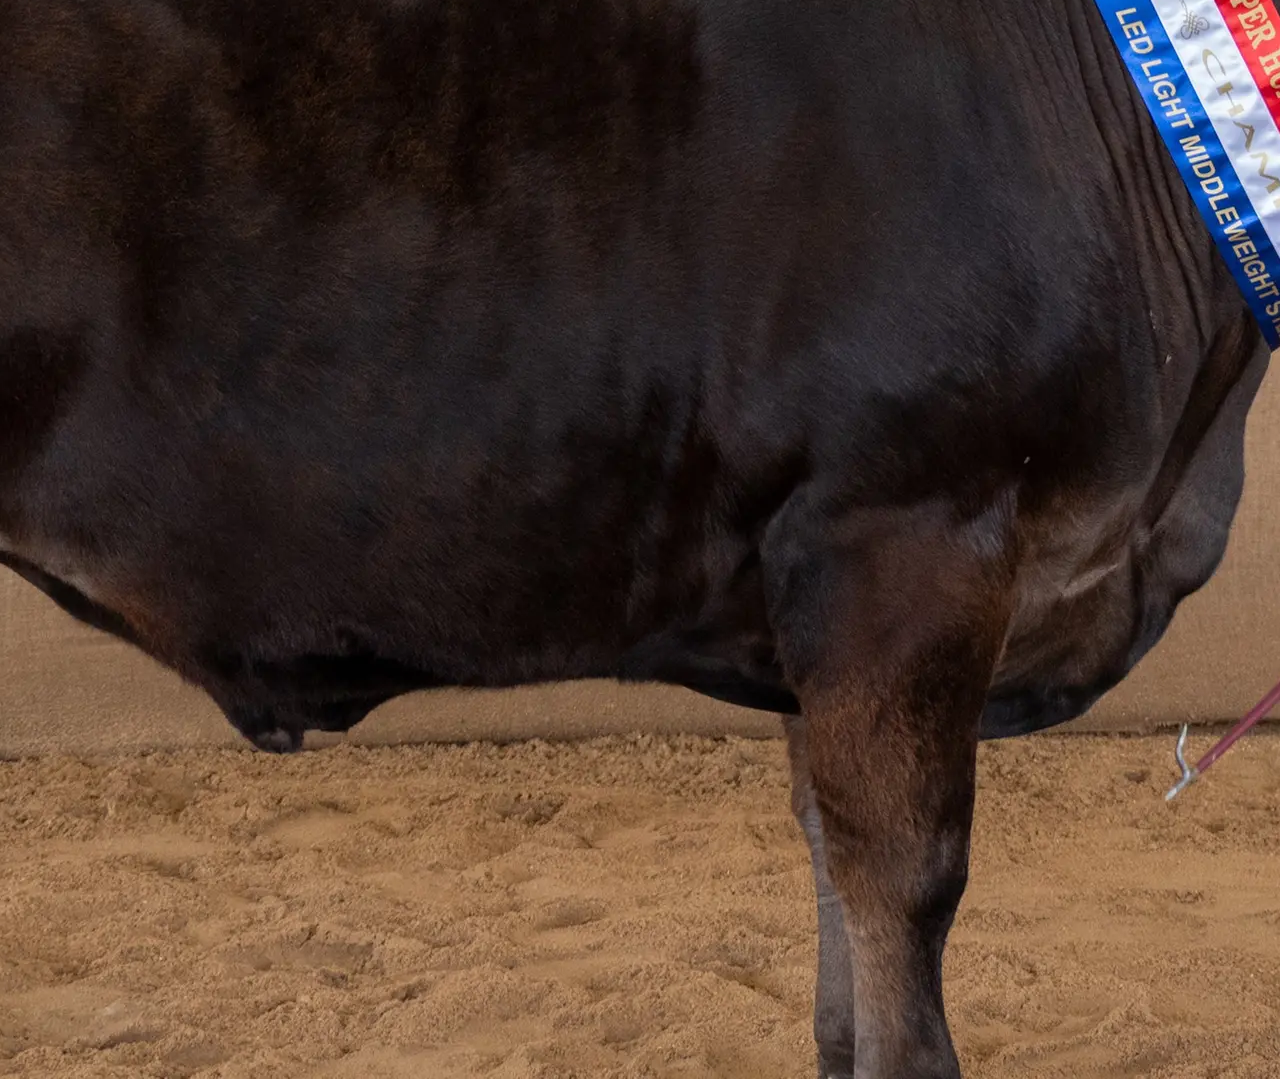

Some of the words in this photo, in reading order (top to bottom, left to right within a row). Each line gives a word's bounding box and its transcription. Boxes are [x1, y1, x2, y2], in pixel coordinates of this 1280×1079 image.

[1115, 7, 1154, 55] LED
[1141, 59, 1195, 128] LIGHT
[1178, 134, 1280, 300] MIDDLEWEIGHT
